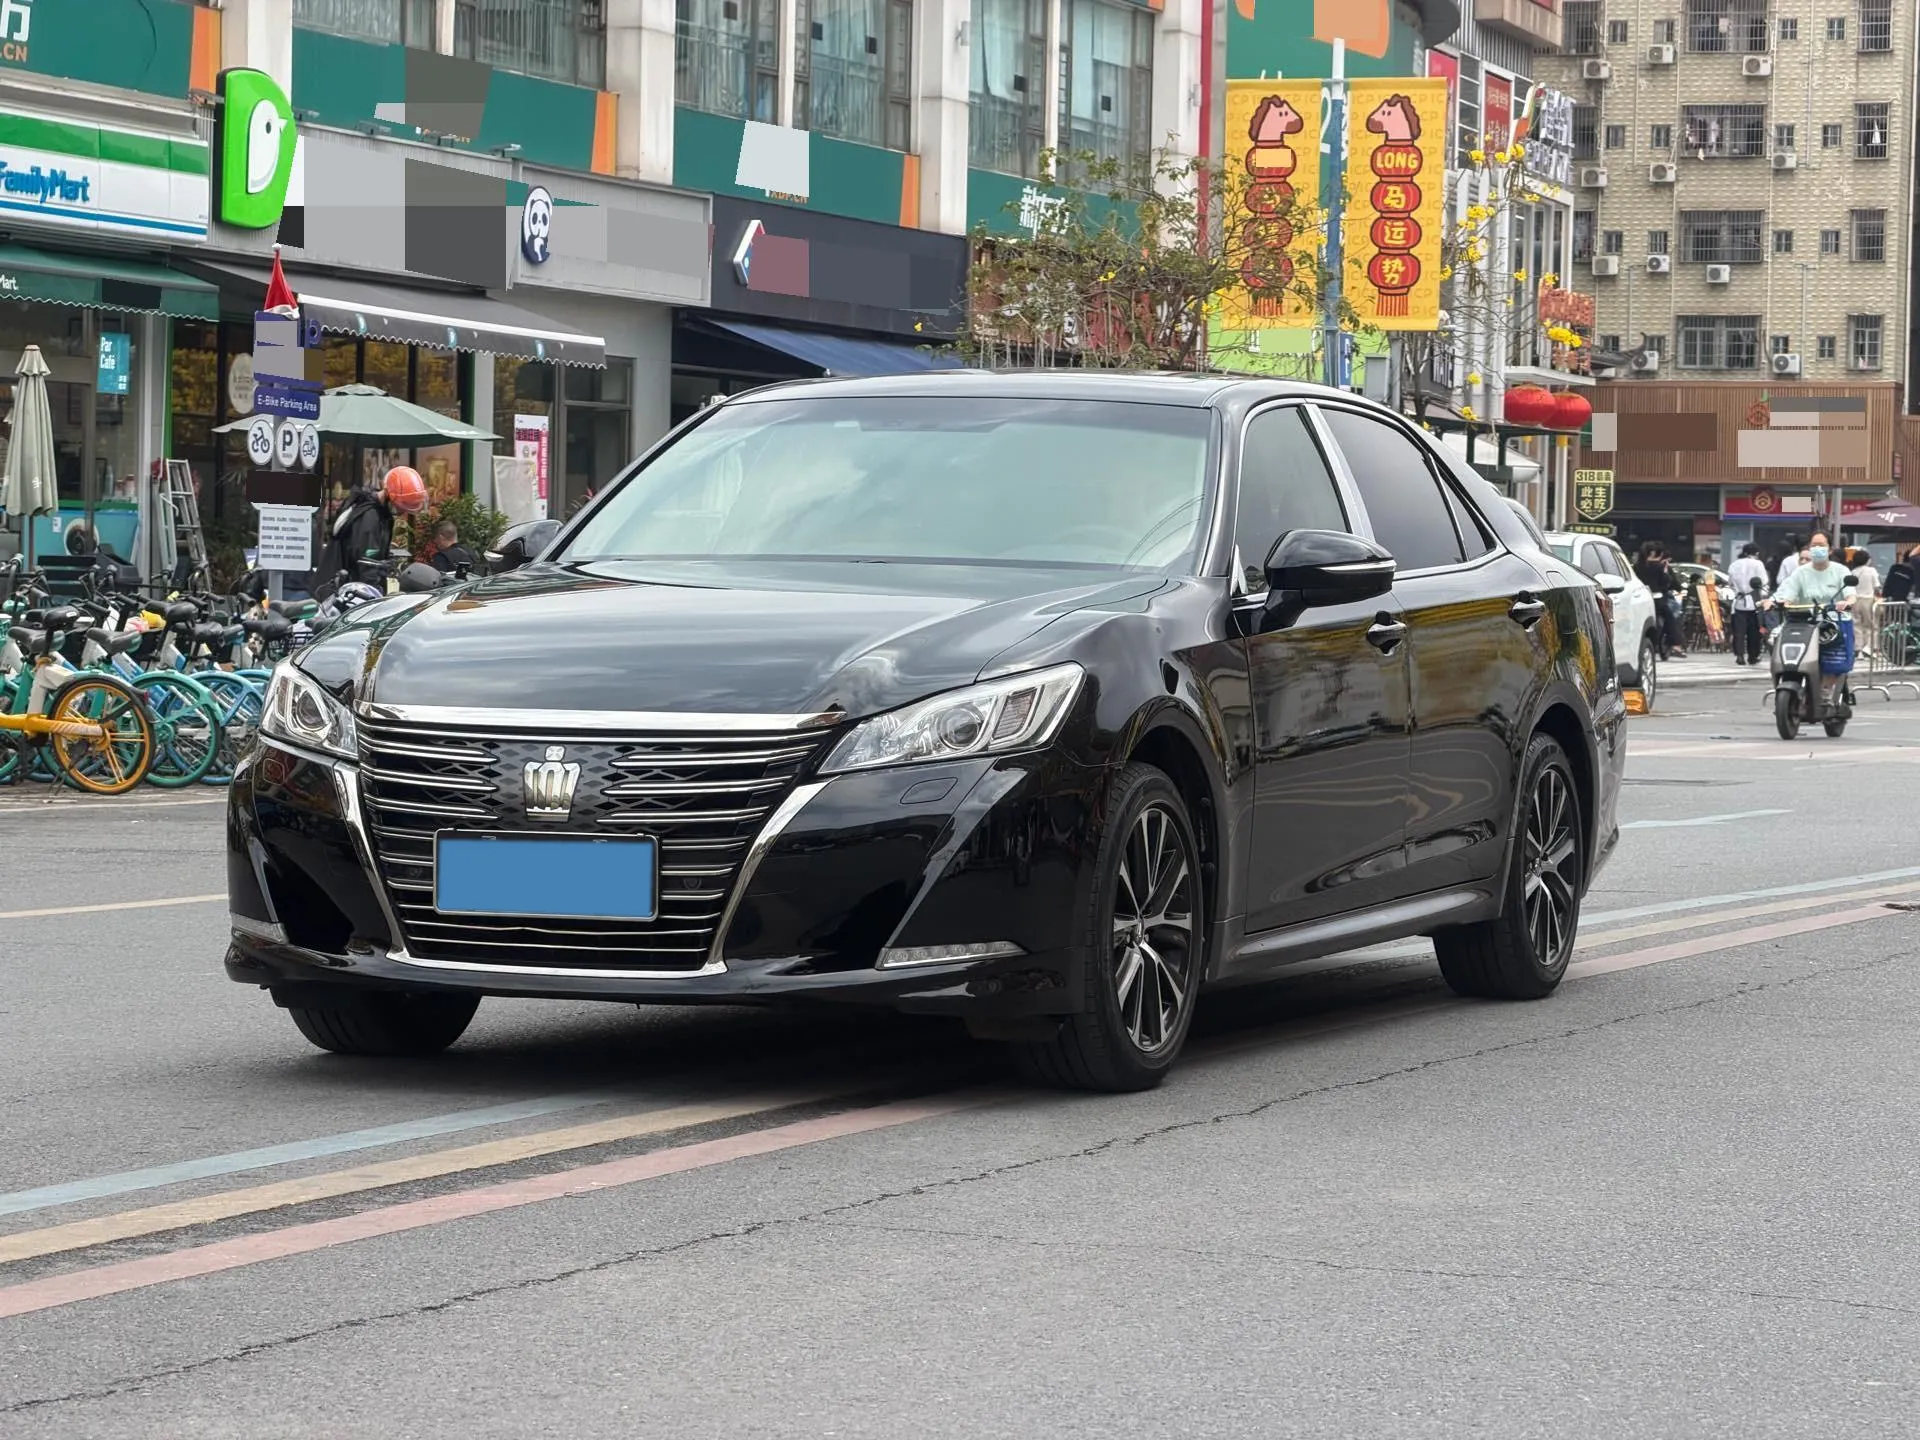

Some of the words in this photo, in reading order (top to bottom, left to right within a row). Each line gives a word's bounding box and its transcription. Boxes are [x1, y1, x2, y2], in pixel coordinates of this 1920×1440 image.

[1375, 151, 1419, 169] LONG
[257, 394, 279, 407] E-Bike
[280, 397, 303, 412] Parking
[304, 400, 317, 412] Area
